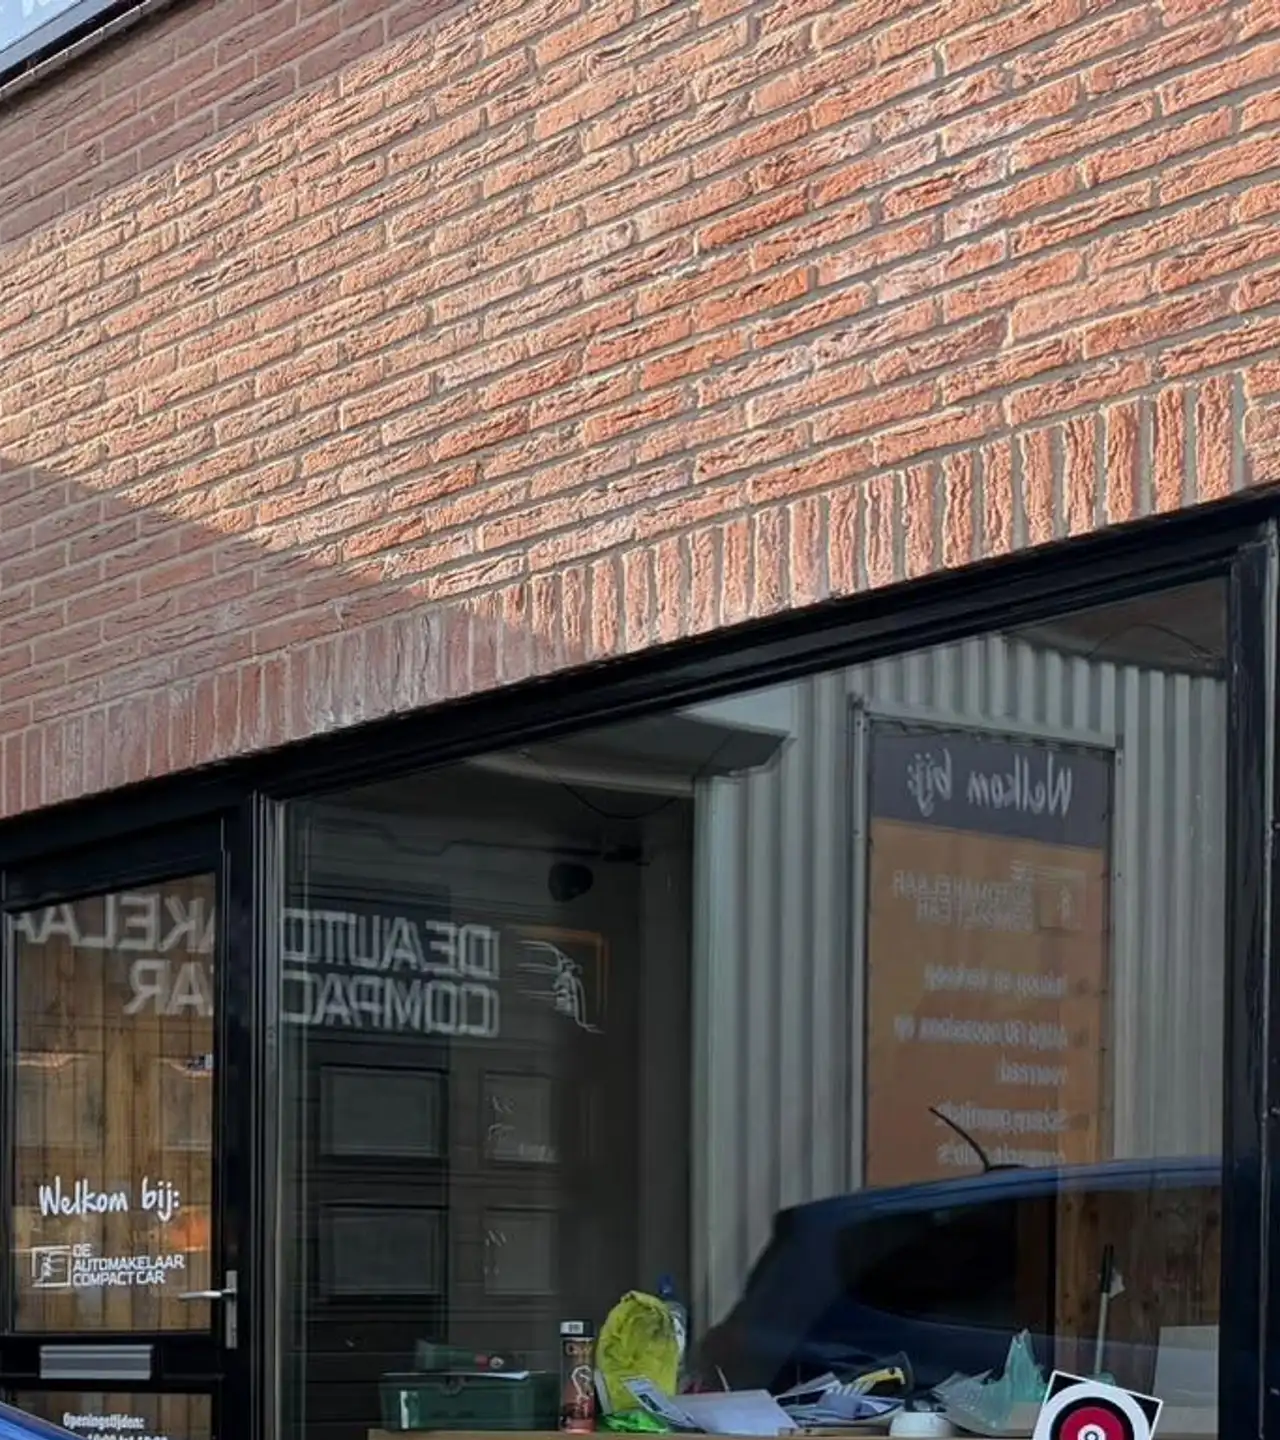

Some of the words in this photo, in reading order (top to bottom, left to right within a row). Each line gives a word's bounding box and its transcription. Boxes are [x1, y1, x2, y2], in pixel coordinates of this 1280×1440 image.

[39, 1175, 128, 1217] Welkom
[142, 1176, 181, 1222] bij:
[72, 1243, 93, 1258] DE
[72, 1254, 186, 1271] AUTOMAKELAAR
[72, 1270, 135, 1287] COMPACT
[136, 1269, 167, 1285] CAR
